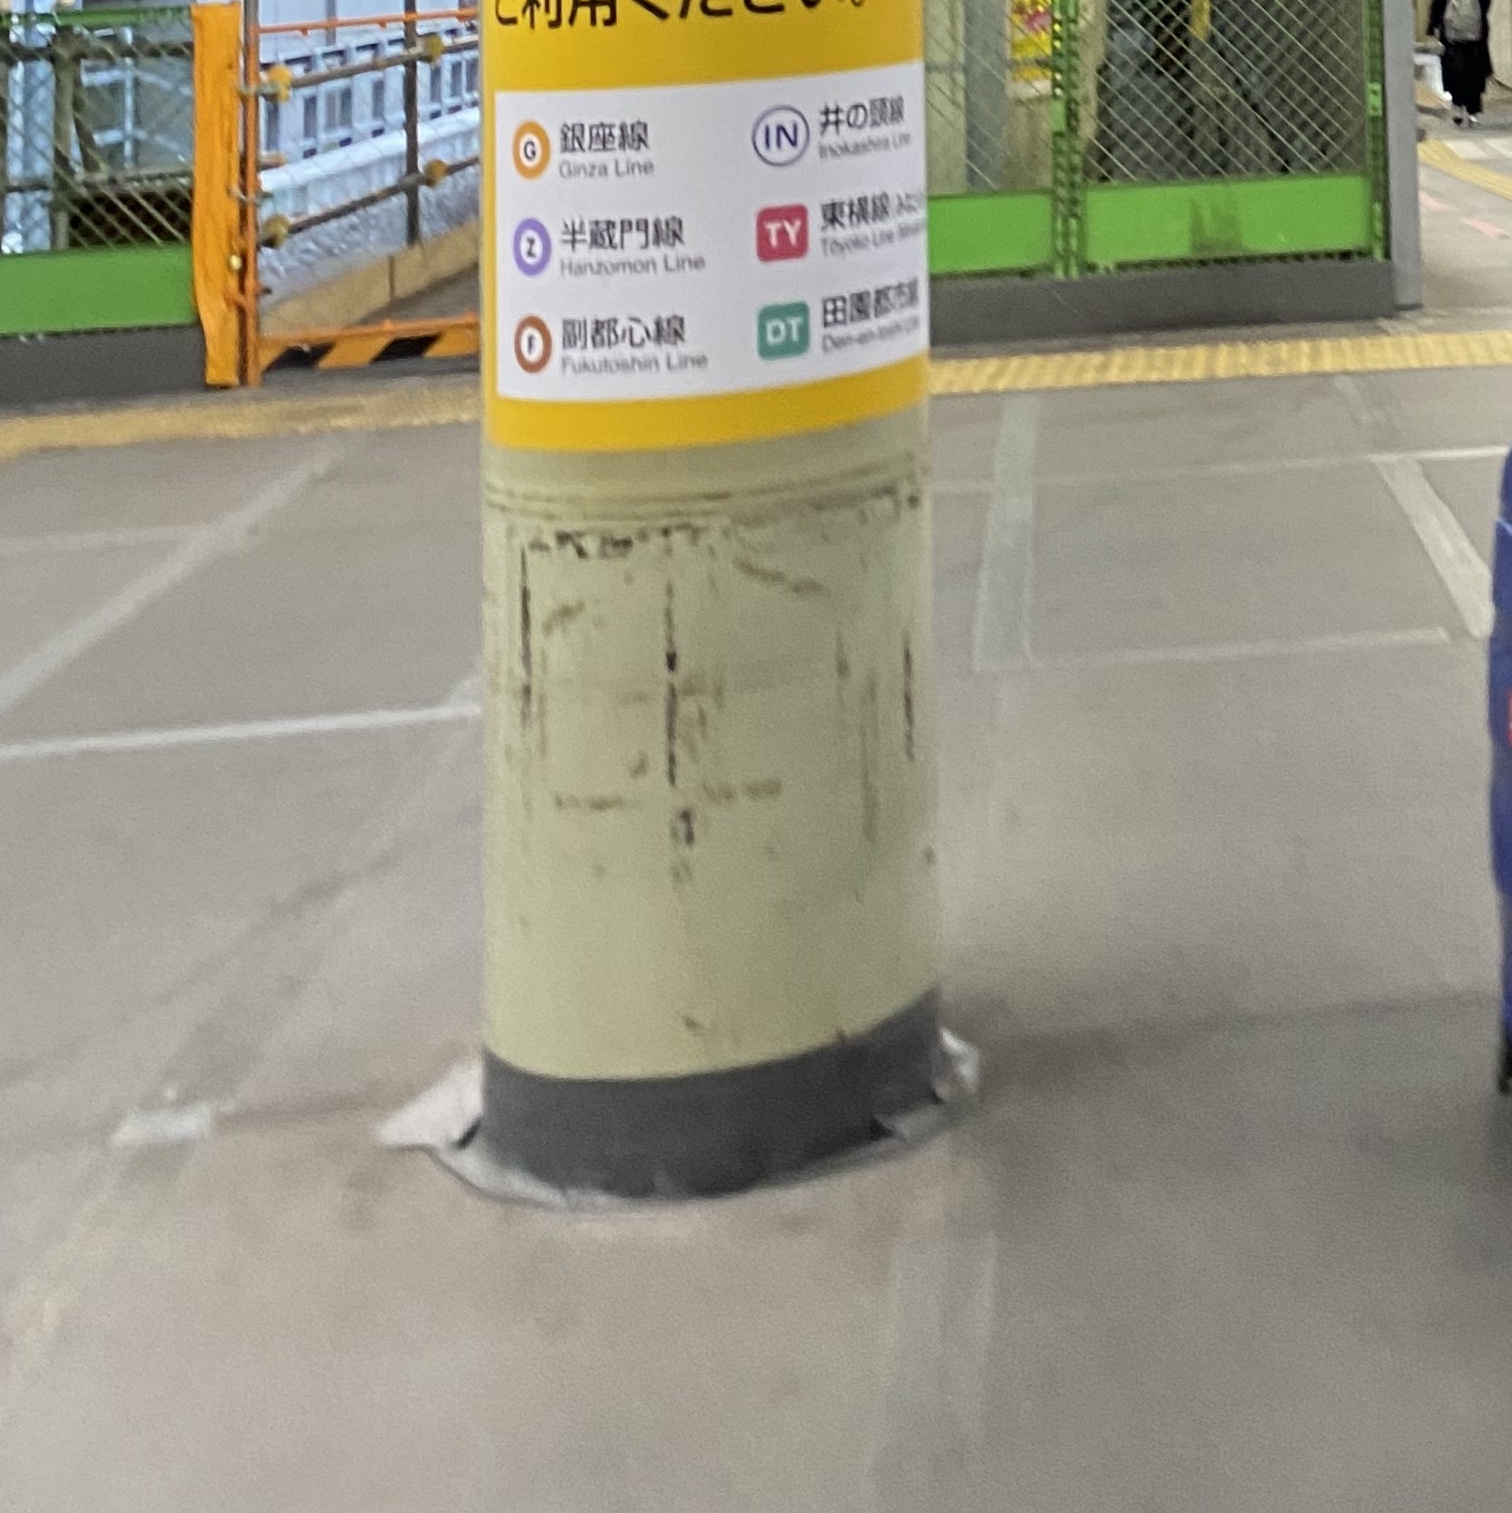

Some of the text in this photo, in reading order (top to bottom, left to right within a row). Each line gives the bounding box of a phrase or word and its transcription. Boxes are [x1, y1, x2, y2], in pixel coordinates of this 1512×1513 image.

[560, 119, 649, 153] 銀座線
[765, 121, 798, 150] IN
[523, 140, 536, 161] G
[559, 158, 654, 179] Ginza Line
[561, 214, 685, 252] 半蔵門線
[765, 220, 802, 249] TY
[526, 237, 536, 259] Z
[560, 252, 706, 279] Hanzomon Line
[562, 314, 686, 351] 副都心線
[766, 316, 803, 345] DT
[562, 350, 709, 376] Fukutoshin Line
